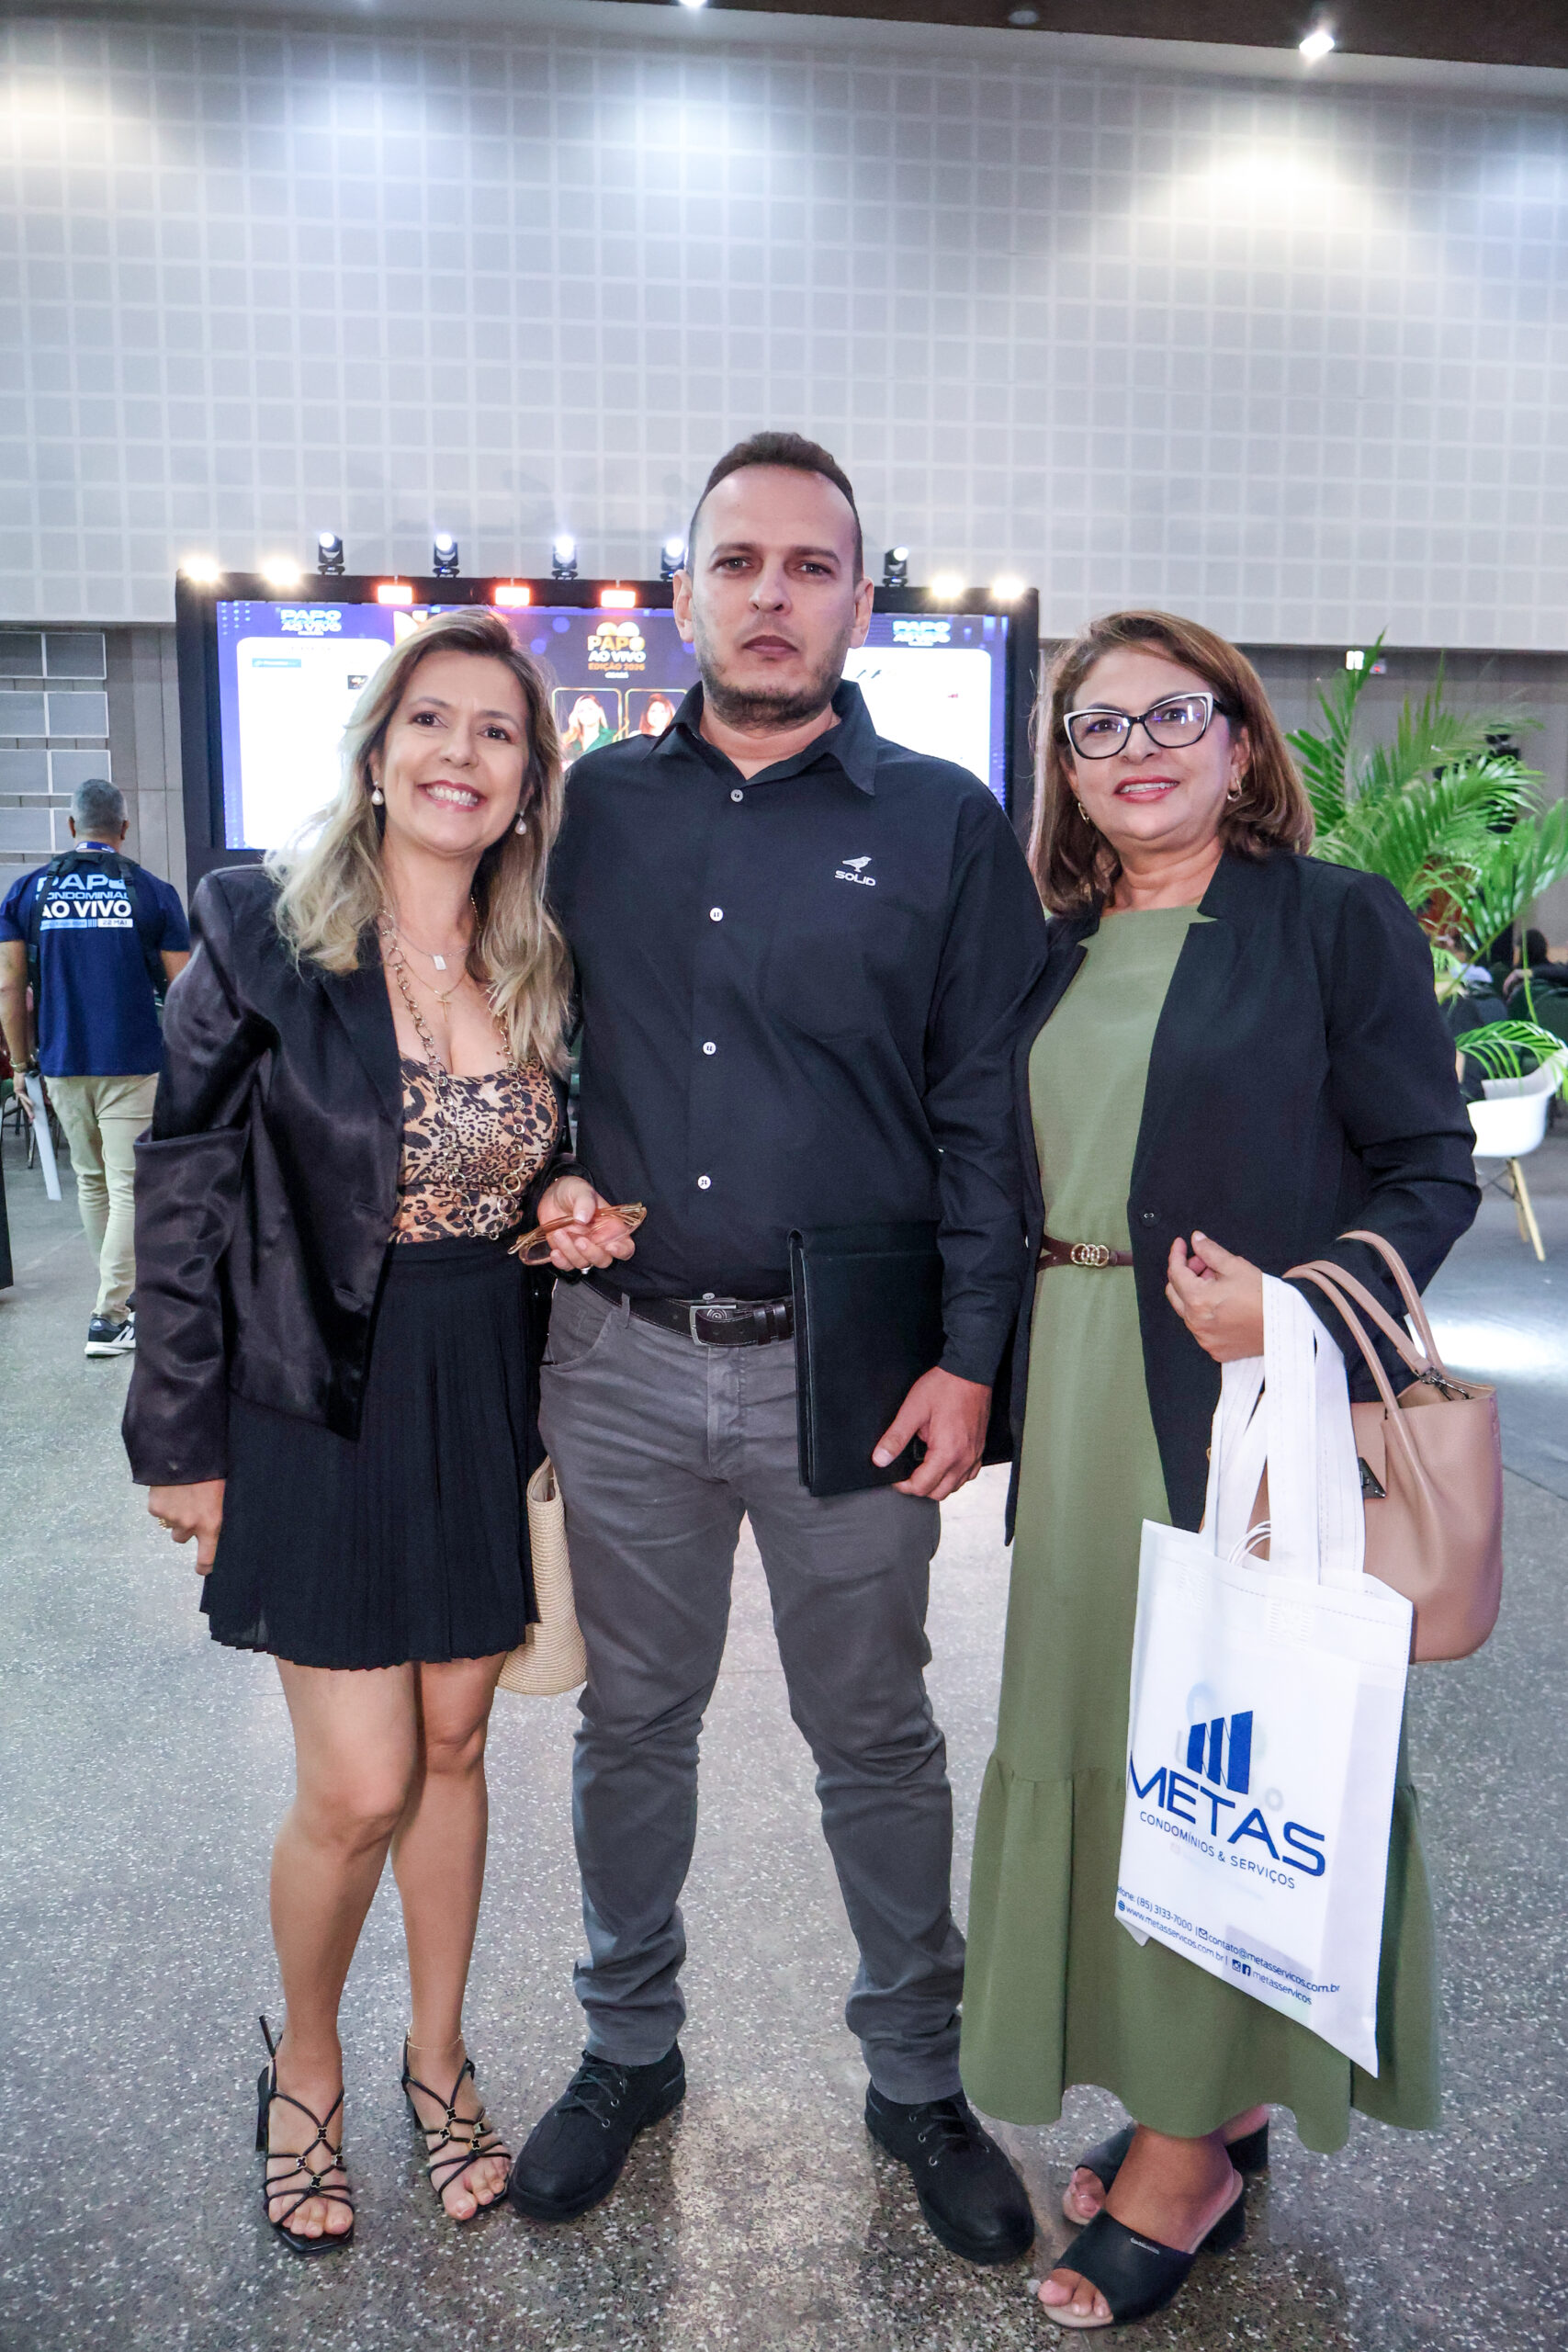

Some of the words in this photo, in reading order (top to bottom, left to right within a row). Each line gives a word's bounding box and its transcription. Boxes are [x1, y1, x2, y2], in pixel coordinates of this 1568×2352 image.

[280, 609, 342, 621] PAPO
[587, 635, 646, 651] PAPO
[588, 650, 610, 662] AO
[610, 650, 647, 662] VIVO
[834, 870, 876, 887] SOLID
[36, 891, 130, 900] ONDOMINIAL
[73, 900, 132, 918] VIVO
[1128, 1749, 1325, 1876] METAS
[1139, 1810, 1215, 1858] CONDOMÍNIOS
[1217, 1849, 1226, 1863] &
[1229, 1854, 1296, 1889] SERVIÇOS
[1136, 1895, 1153, 1912] (85)
[1154, 1905, 1193, 1932] 3133-7000
[1208, 1933, 1341, 1993] contato@metasservicos.com.br
[1125, 1906, 1224, 1962] www.metasservicos.com.br
[1252, 1971, 1313, 2006] metasservicos
